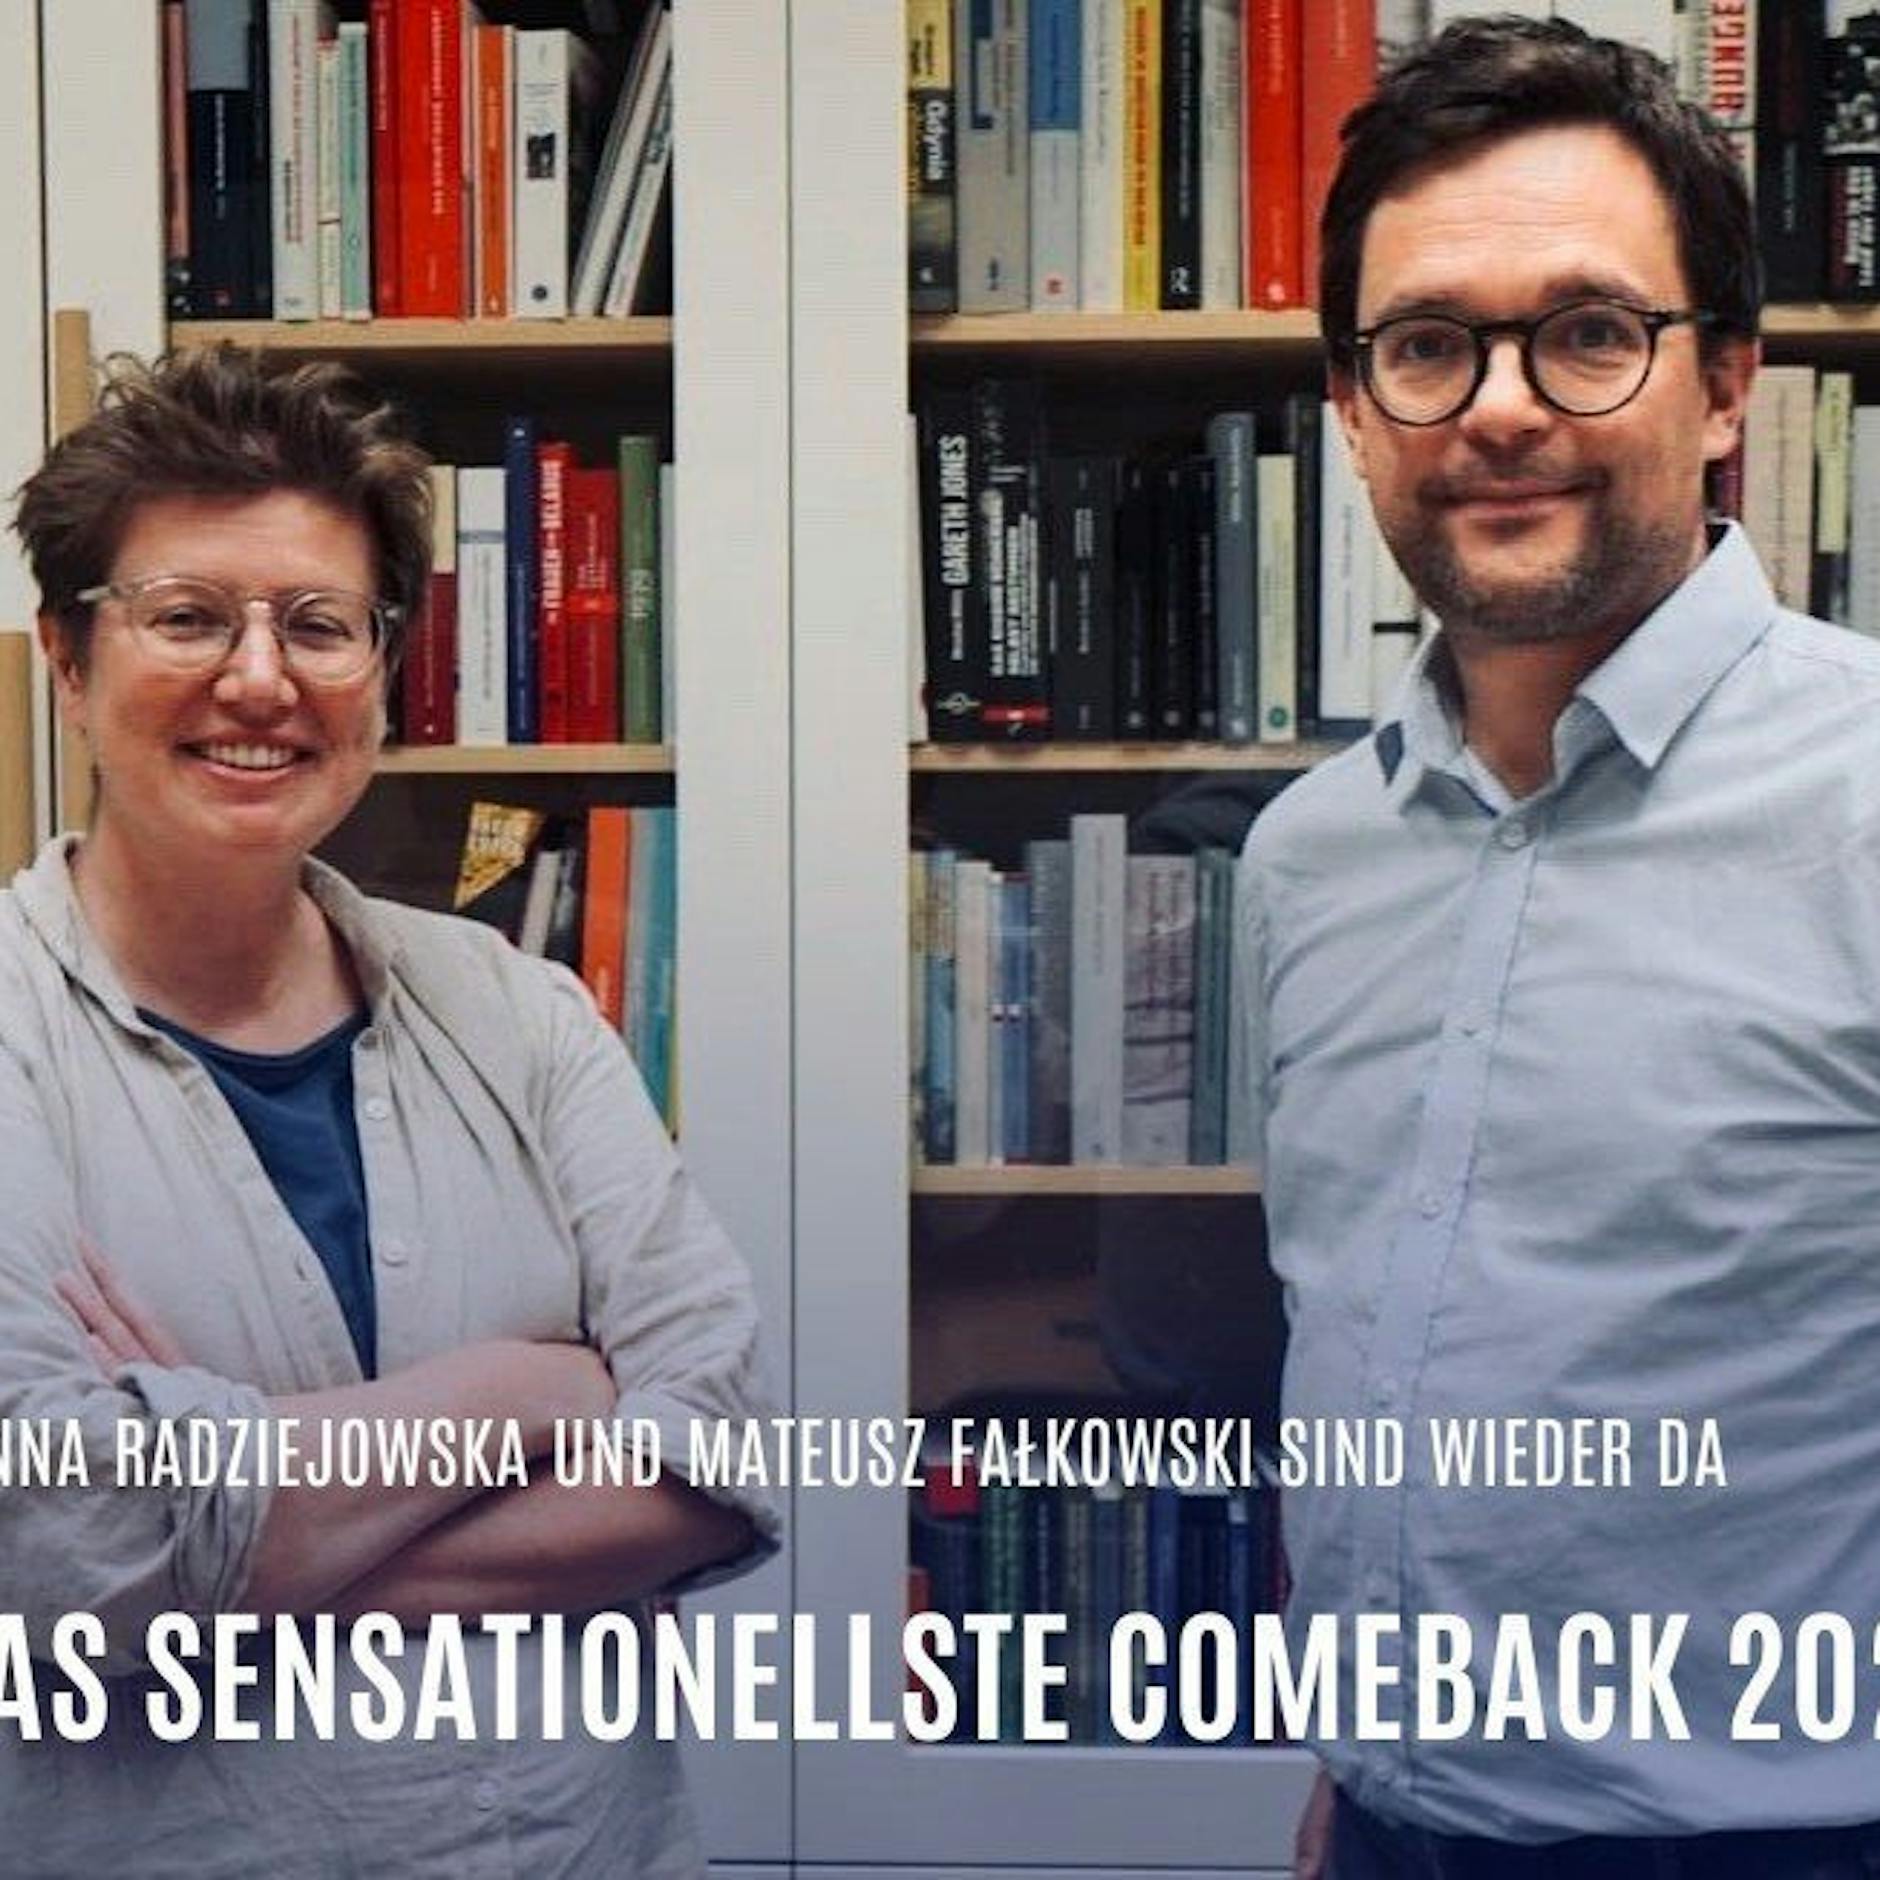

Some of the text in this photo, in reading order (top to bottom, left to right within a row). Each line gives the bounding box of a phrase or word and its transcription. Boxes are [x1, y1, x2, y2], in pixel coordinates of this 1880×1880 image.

[923, 100, 949, 180] Gdynia
[938, 435, 968, 498] JONES
[940, 502, 970, 586] GARETH
